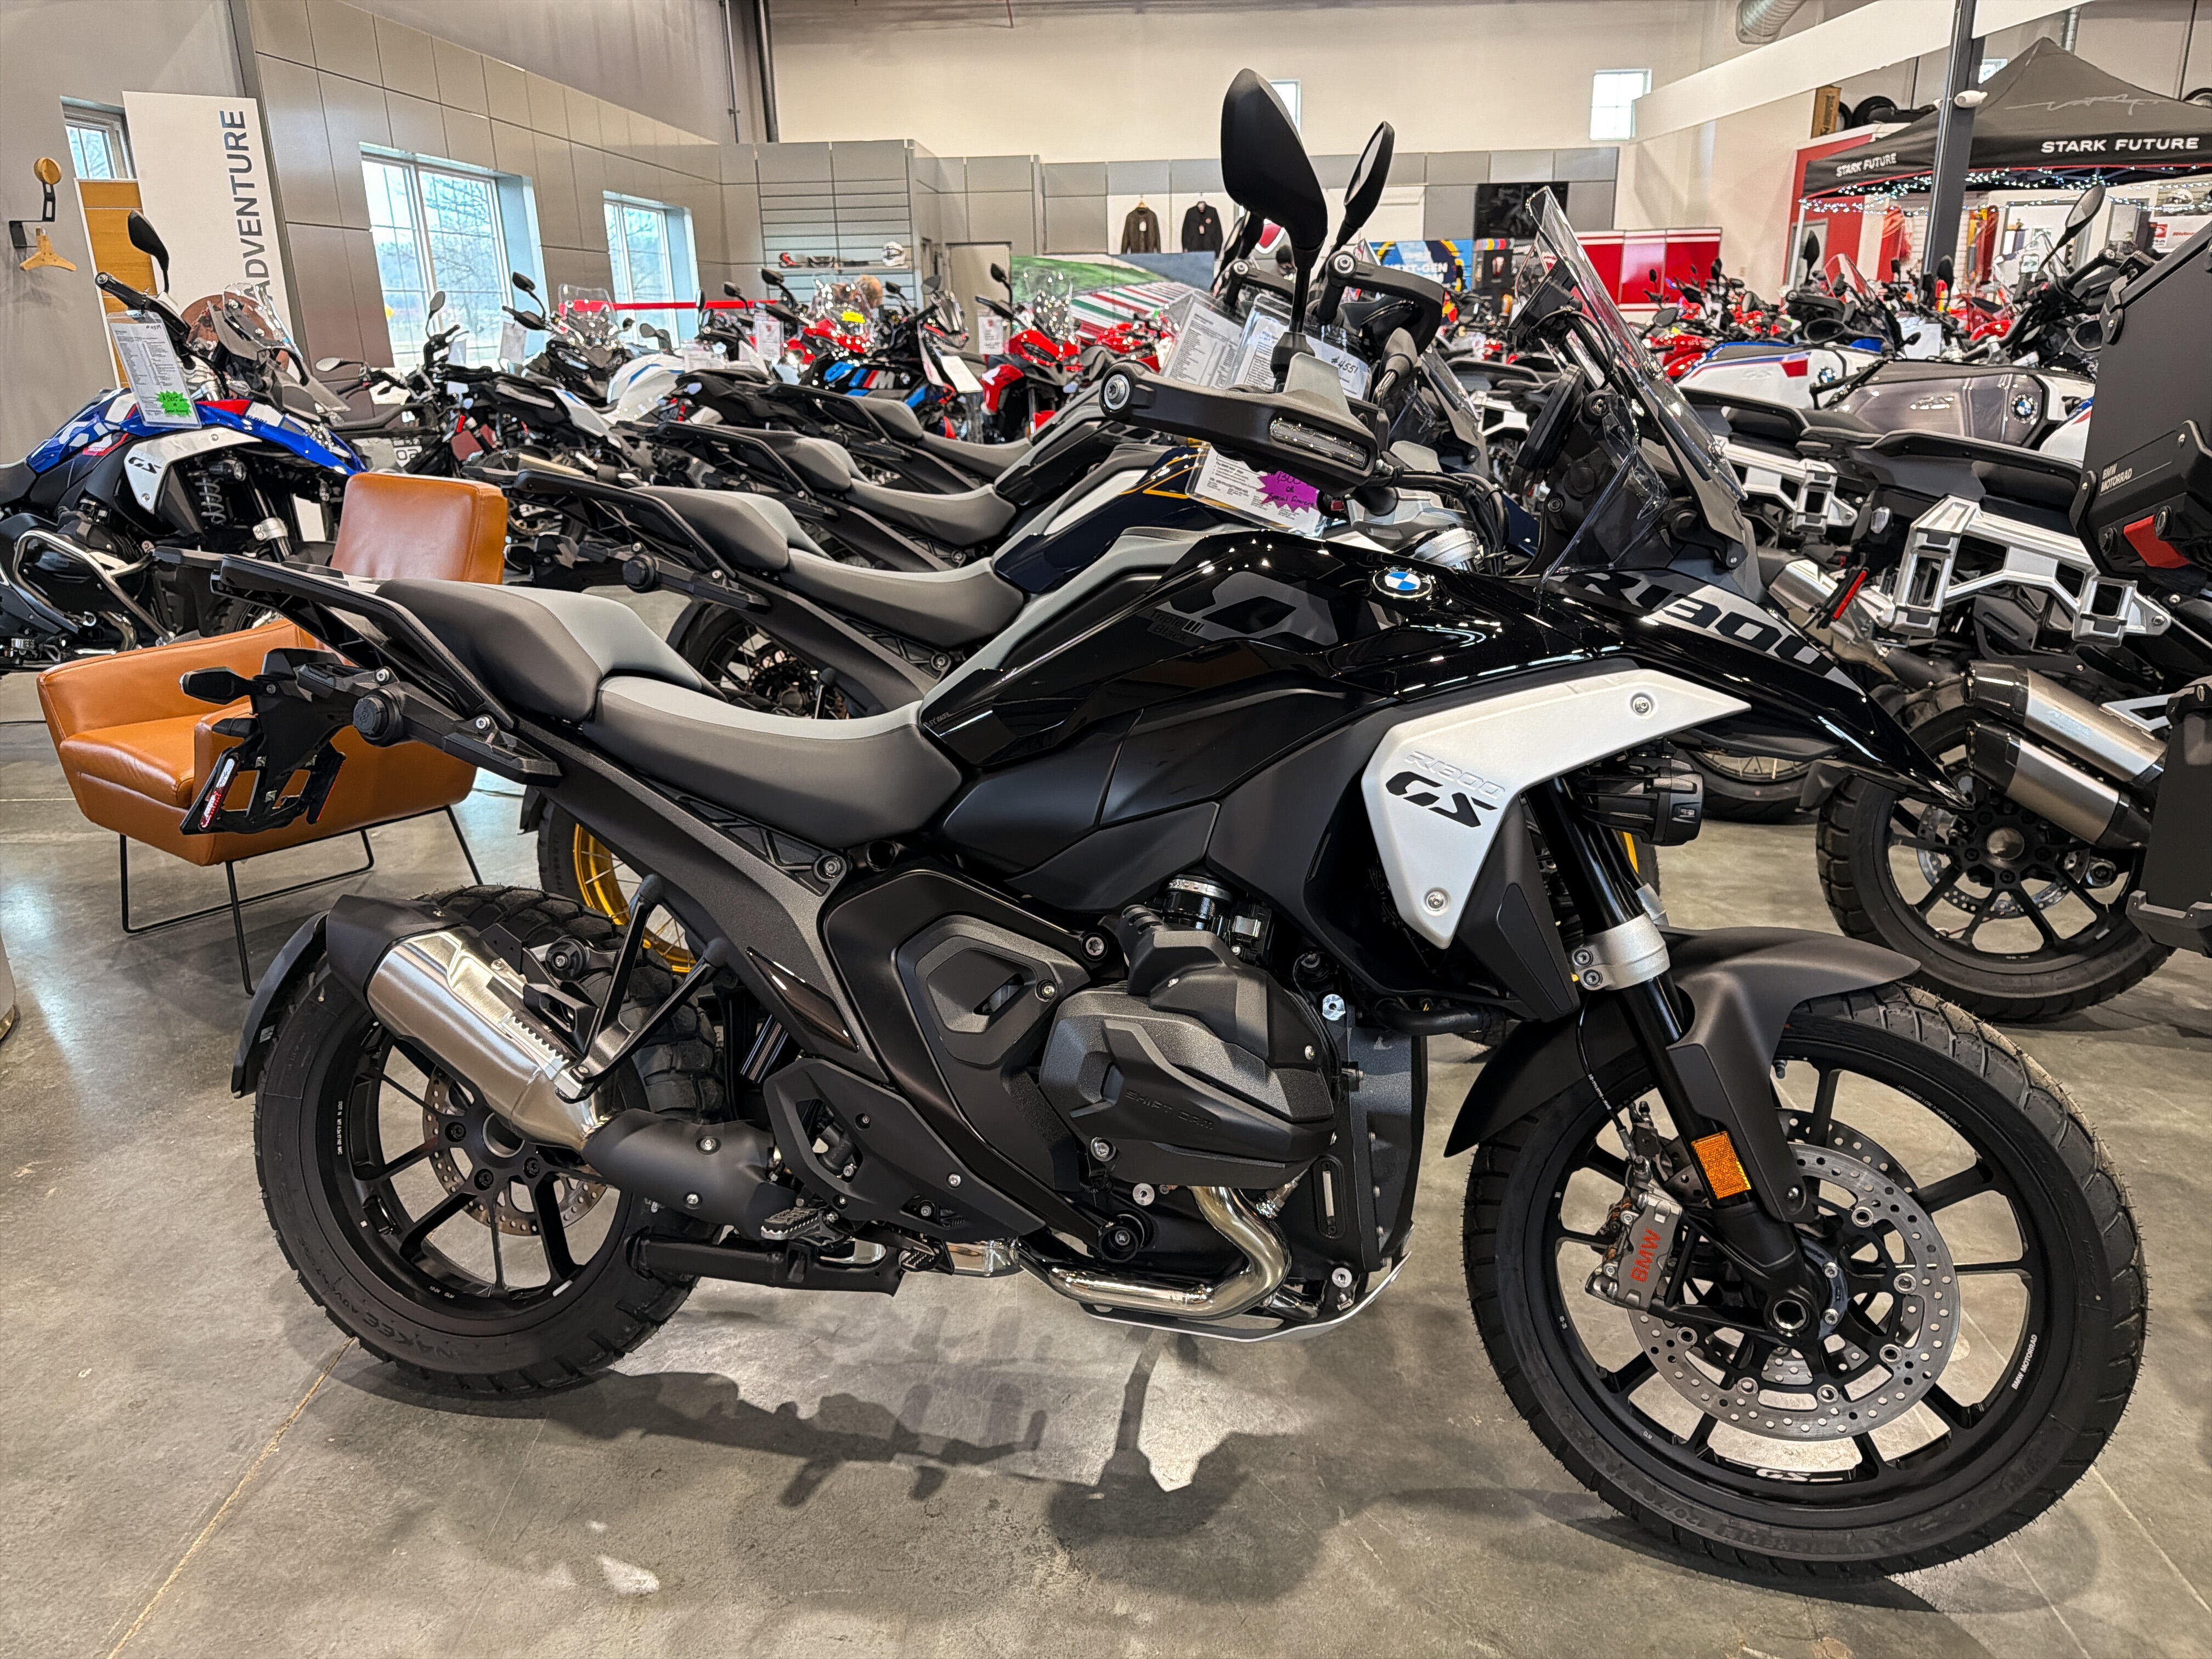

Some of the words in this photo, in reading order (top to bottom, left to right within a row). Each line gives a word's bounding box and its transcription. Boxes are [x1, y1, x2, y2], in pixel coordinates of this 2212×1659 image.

[2040, 139, 2107, 154] STARK
[2114, 137, 2200, 151] FUTURE
[1836, 161, 1863, 177] STARK
[1863, 153, 1897, 170] FUTURE
[219, 110, 273, 302] ADVENTURE
[128, 456, 163, 475] GS
[2102, 462, 2118, 481] BMW
[2100, 467, 2133, 493] MOTORRAD
[1153, 623, 1187, 644] Black
[1385, 771, 1499, 828] GS
[1629, 1228, 1661, 1283] BMW
[362, 1311, 459, 1360] NAKEE
[2011, 1371, 2024, 1390] BMW
[2020, 1334, 2038, 1373] MOTORRAD
